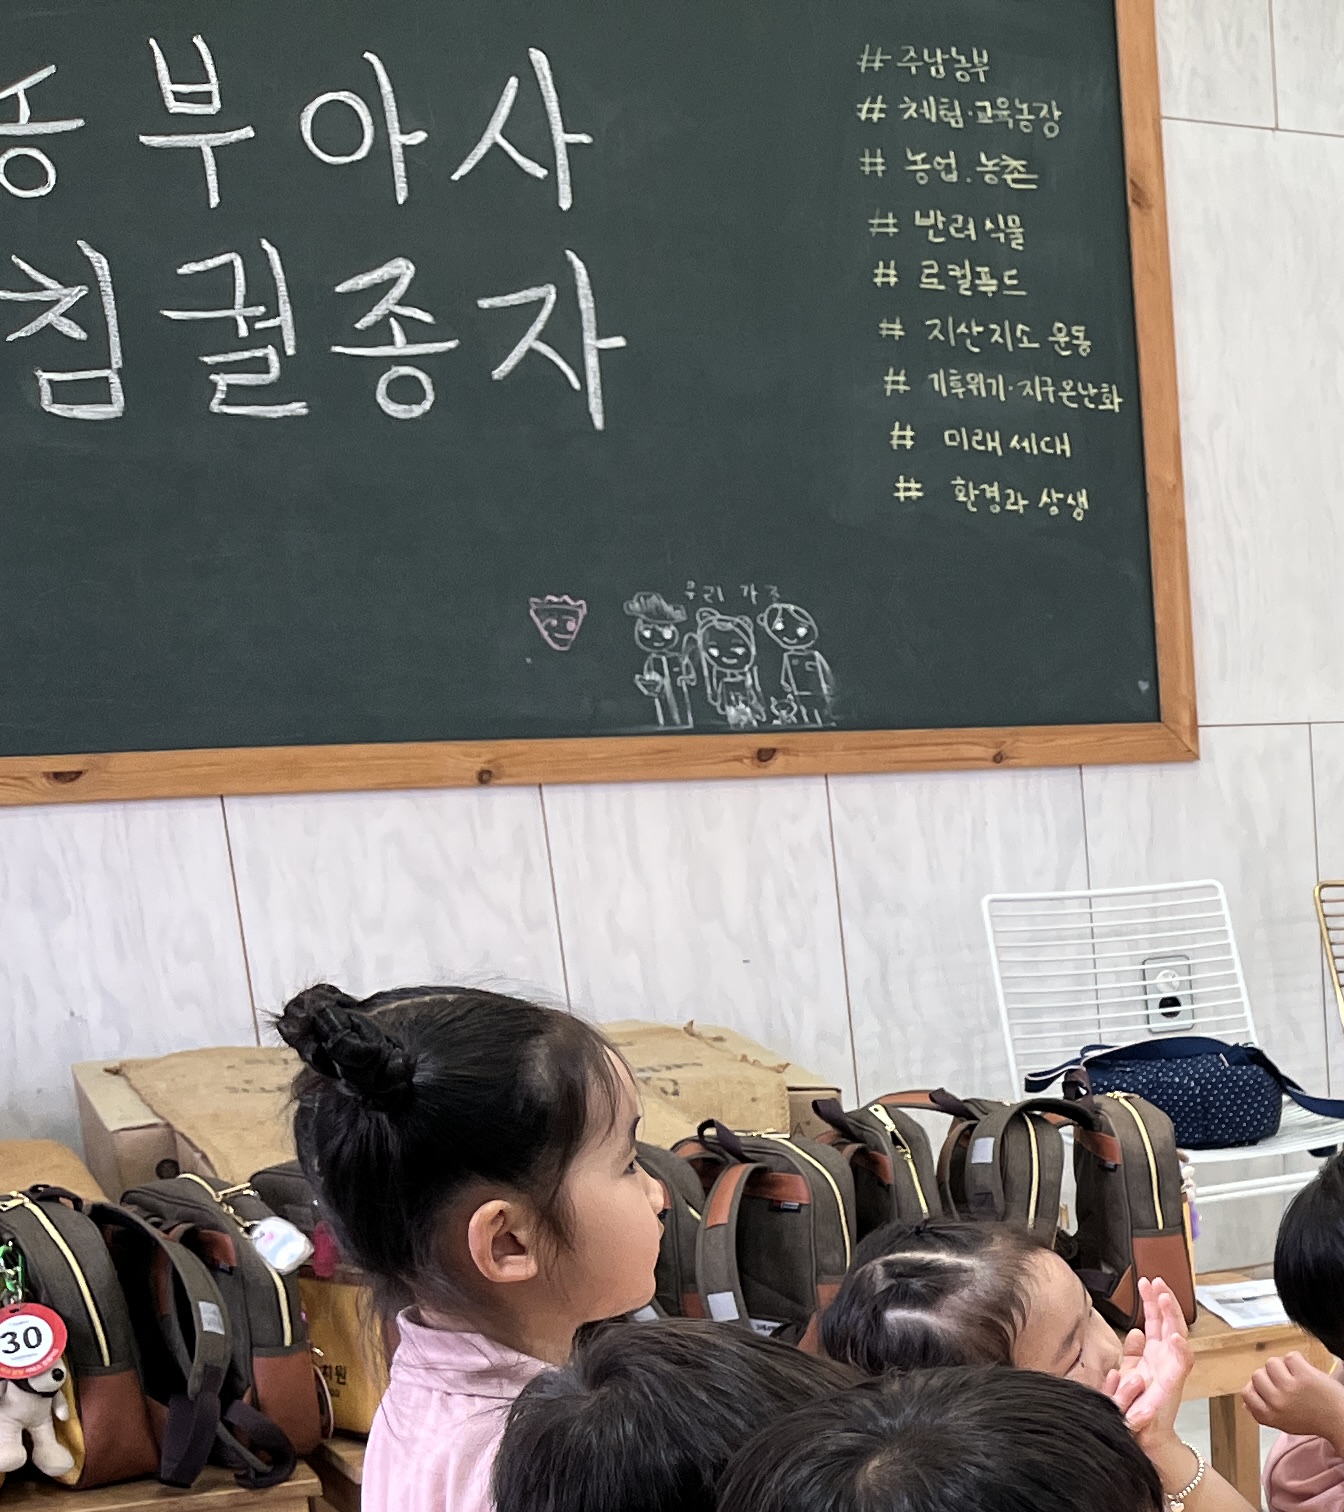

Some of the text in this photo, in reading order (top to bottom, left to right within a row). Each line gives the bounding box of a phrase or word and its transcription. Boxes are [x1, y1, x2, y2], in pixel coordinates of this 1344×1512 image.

[896, 45, 990, 83] 주남농부
[919, 258, 1028, 298] 로컬푸드
[924, 315, 1041, 353] 지산지소
[1047, 321, 1092, 358] 운동
[950, 475, 1030, 514] 환경과
[1037, 487, 1089, 522] 상생
[0, 1326, 43, 1354] 30
